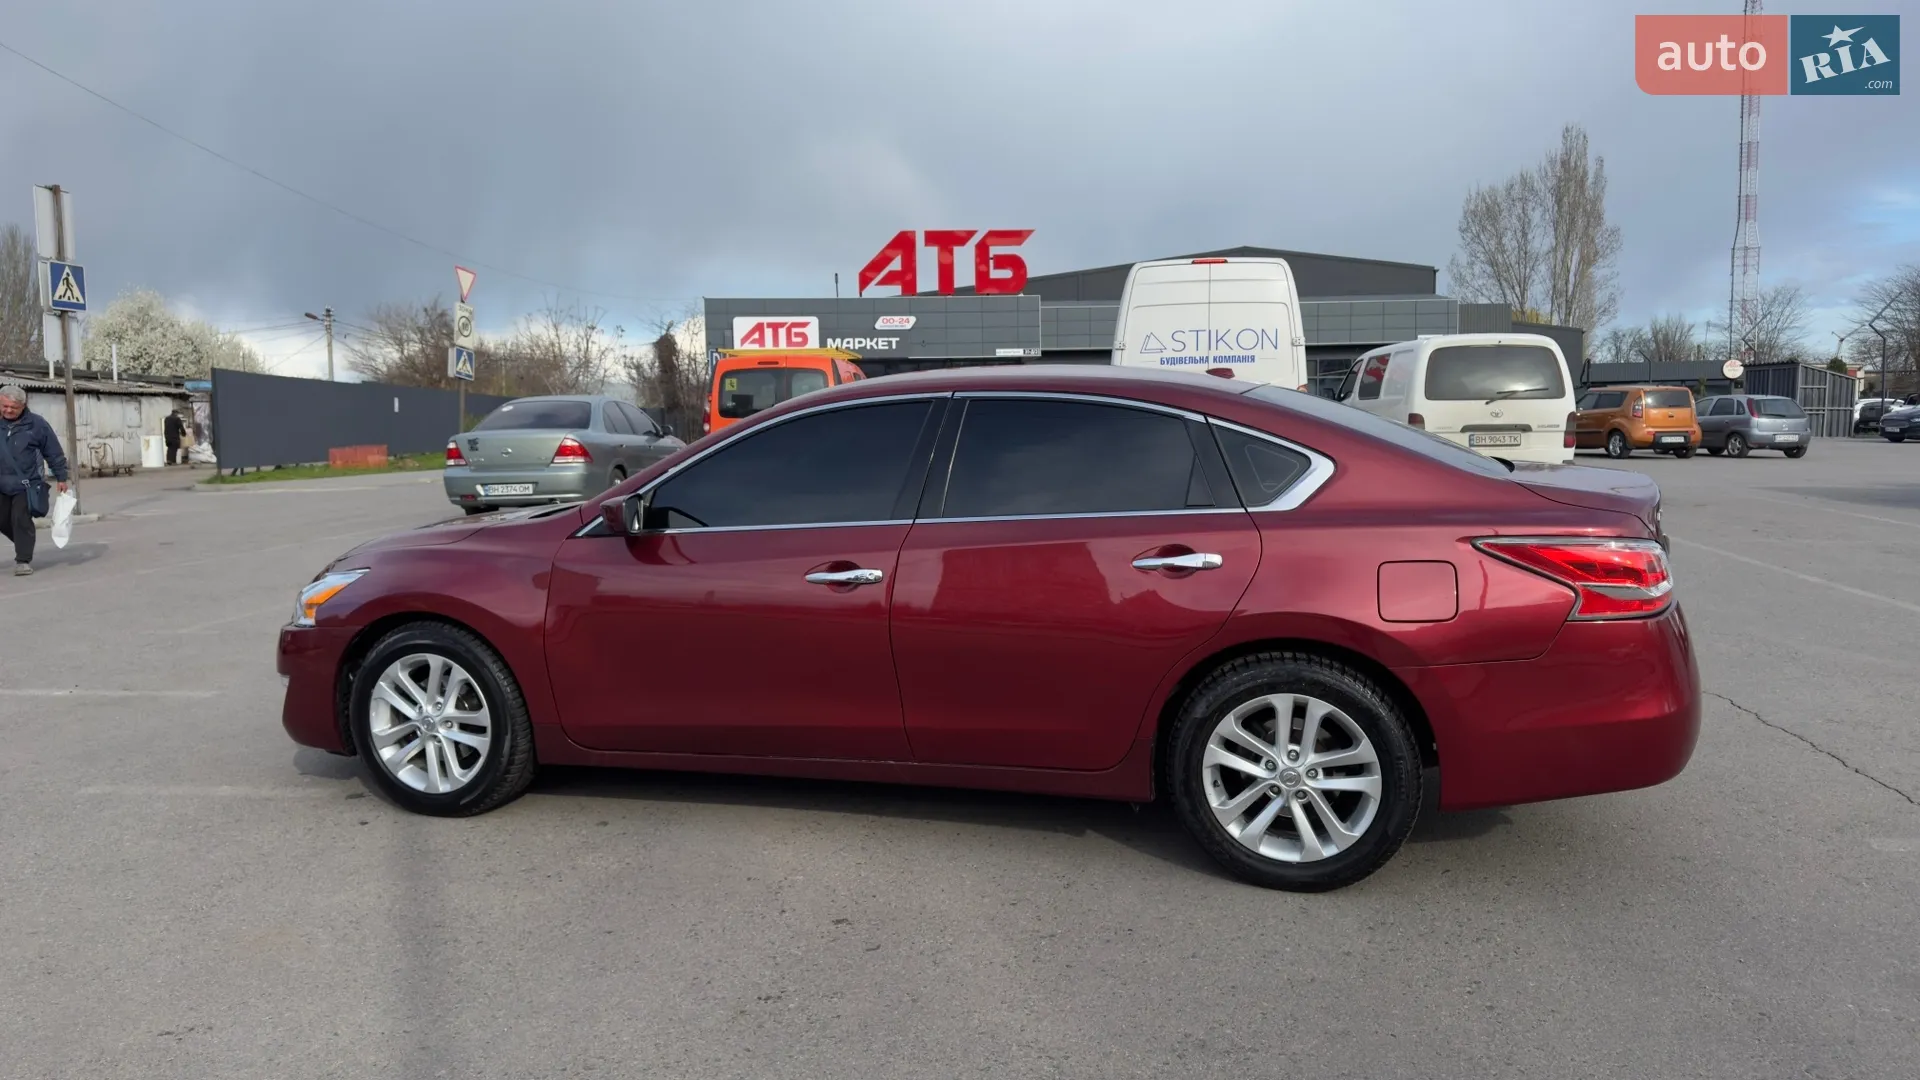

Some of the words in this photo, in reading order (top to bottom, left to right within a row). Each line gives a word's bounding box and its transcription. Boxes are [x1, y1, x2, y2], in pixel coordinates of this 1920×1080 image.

[858, 229, 1035, 295] АТБ
[739, 321, 811, 348] АТБ
[826, 337, 900, 350] МАРКЕТ
[1171, 328, 1278, 352] STIKON
[1160, 355, 1209, 365] БУДІВЕЛЬНА
[1212, 355, 1256, 364] КОМПАНІЯ
